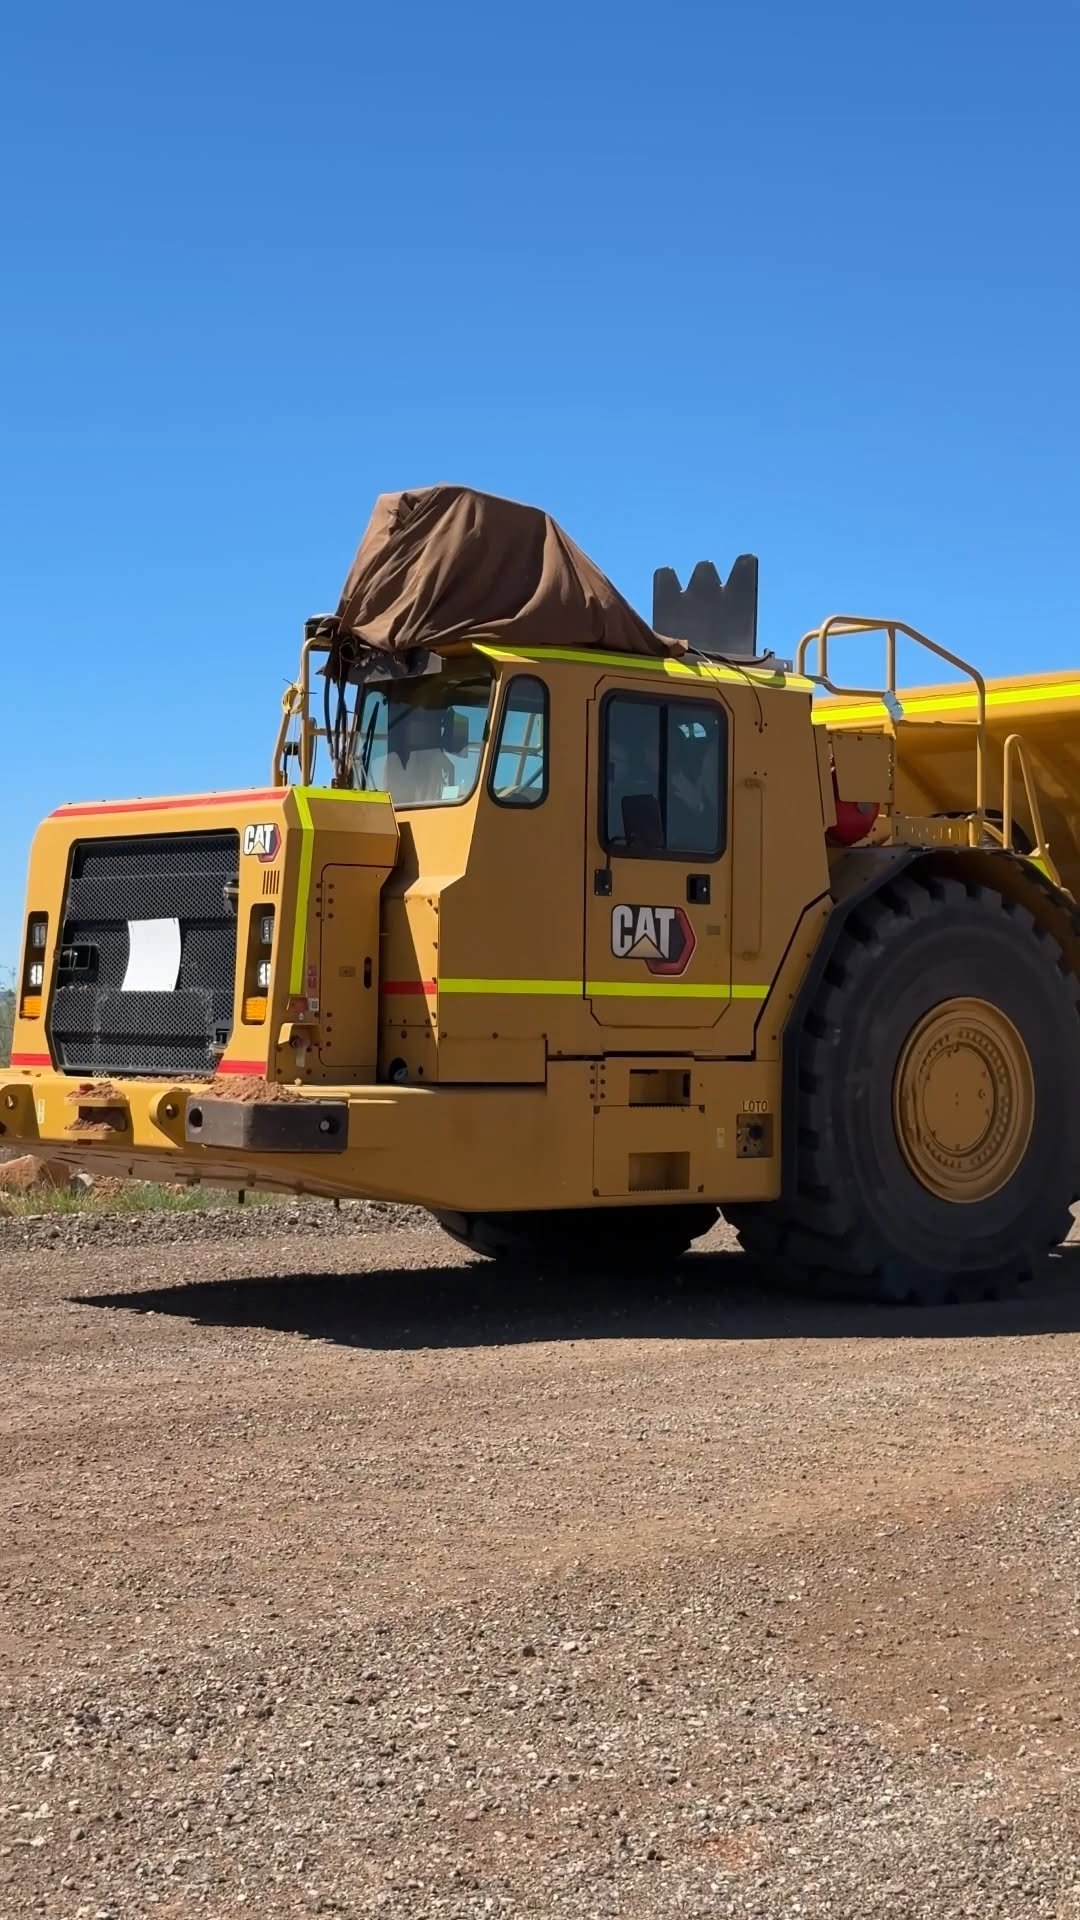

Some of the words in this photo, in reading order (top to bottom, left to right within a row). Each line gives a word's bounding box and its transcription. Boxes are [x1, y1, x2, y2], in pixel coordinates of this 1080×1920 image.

[243, 824, 274, 855] CAT
[612, 905, 675, 959] CAT
[742, 1100, 768, 1112] LOTO
